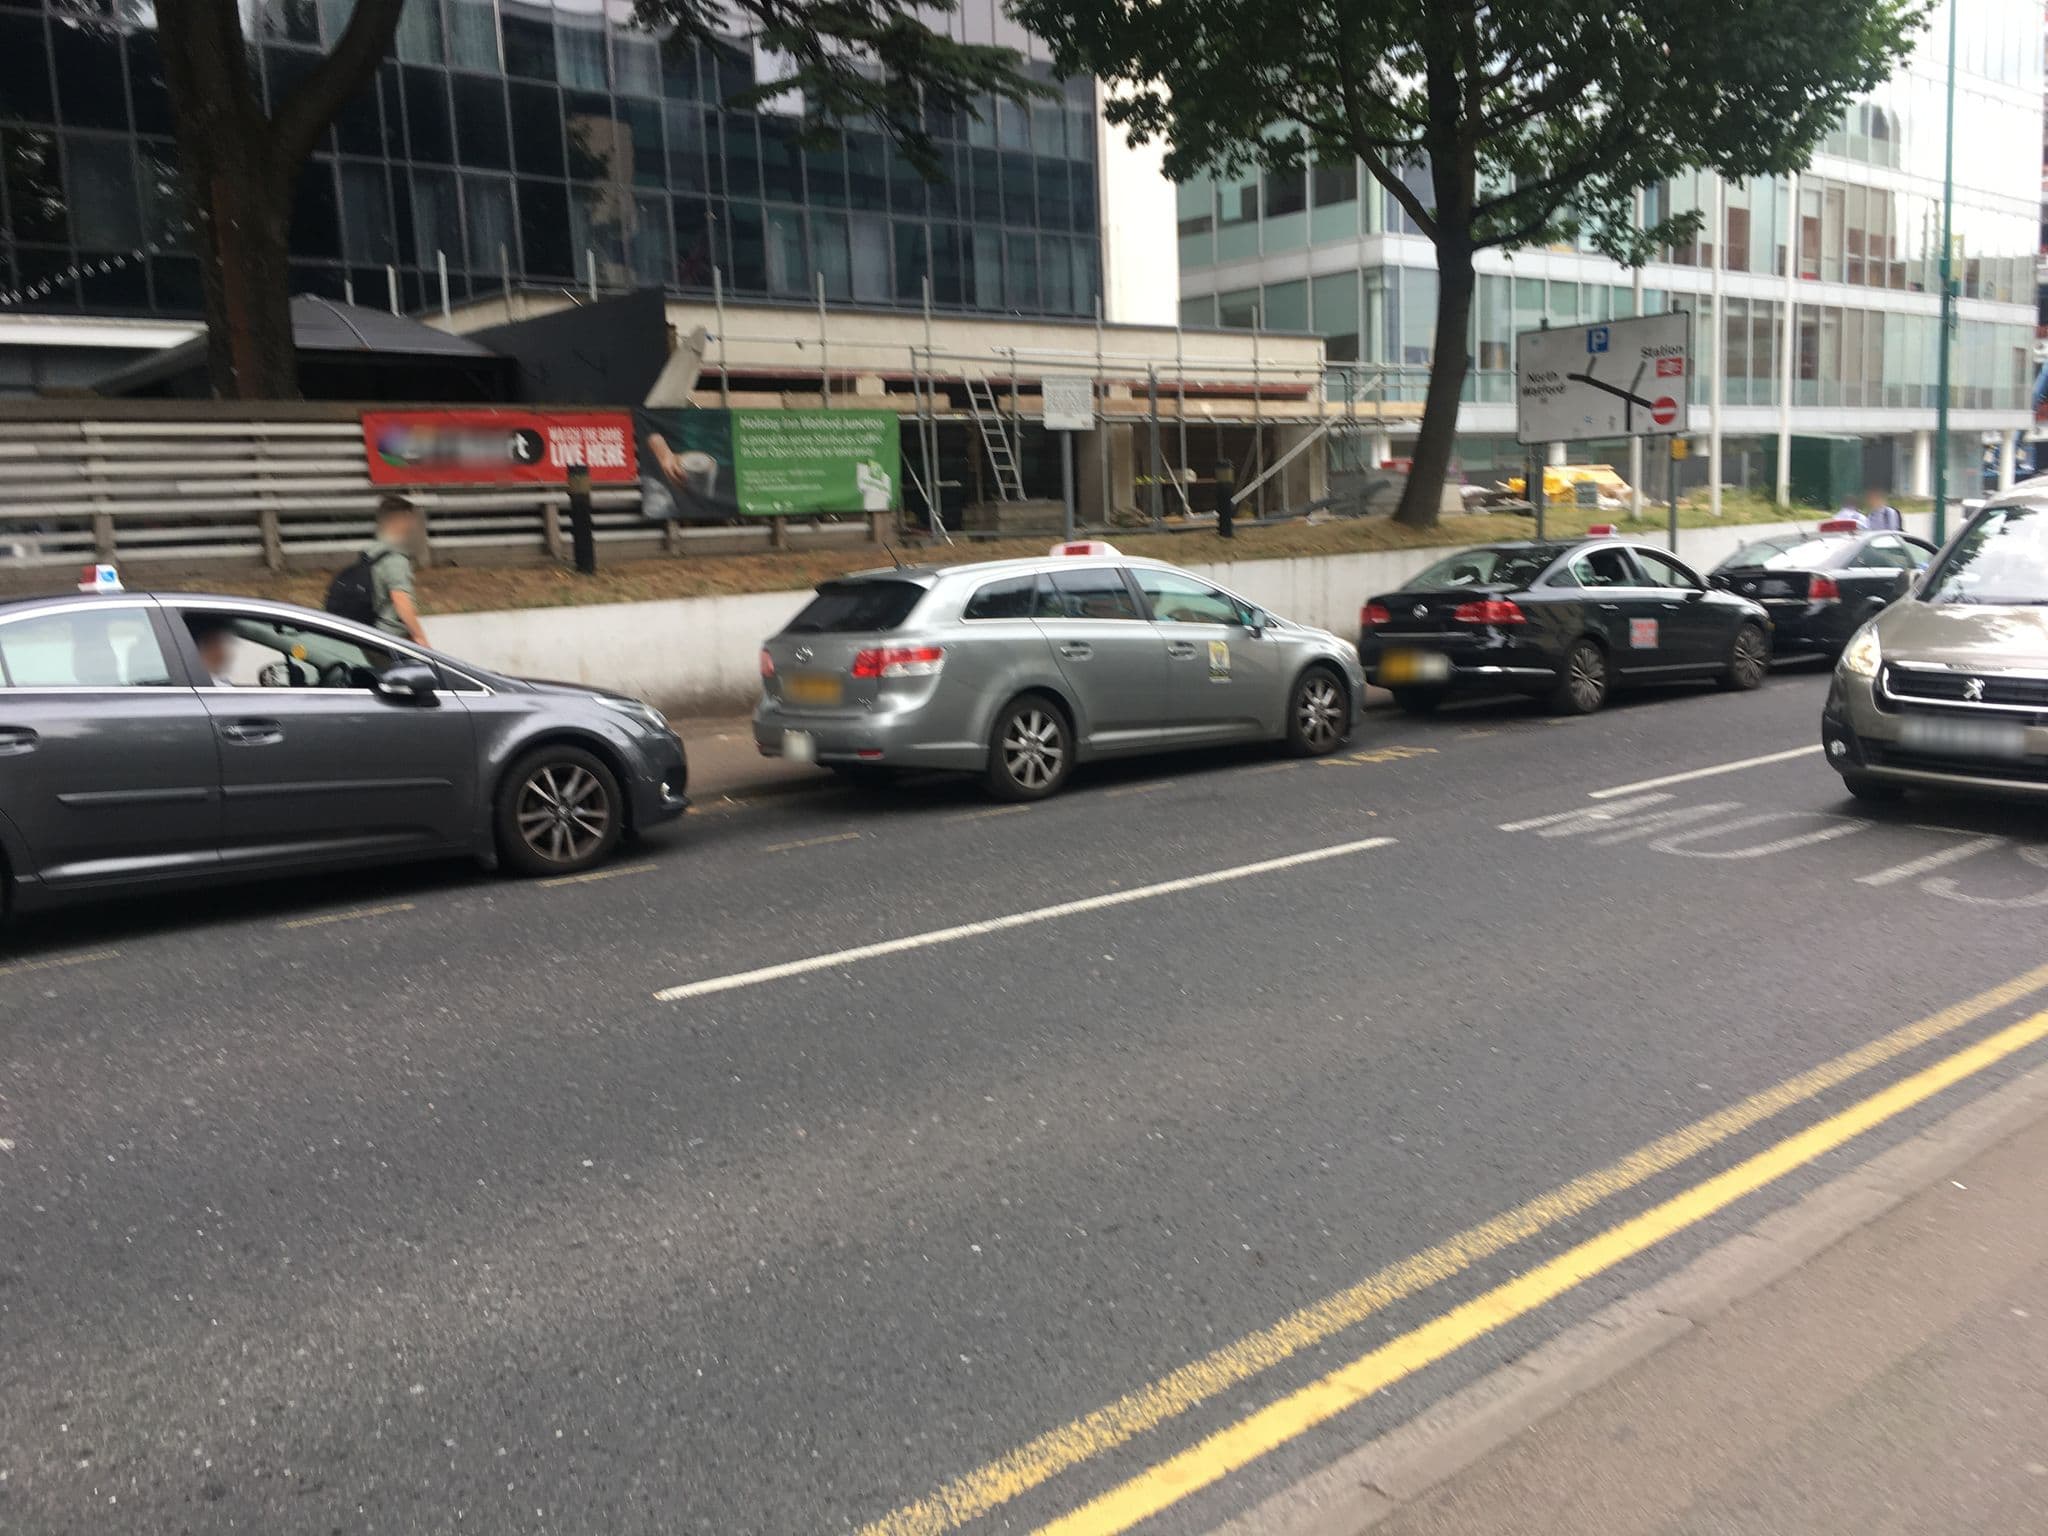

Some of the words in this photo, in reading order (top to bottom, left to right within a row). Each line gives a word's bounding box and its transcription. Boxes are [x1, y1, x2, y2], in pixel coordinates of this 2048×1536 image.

[1641, 344, 1685, 359] Station
[1527, 371, 1559, 385] North
[1522, 384, 1567, 398] Watford
[550, 442, 586, 467] LIVE
[586, 442, 627, 467] HERE
